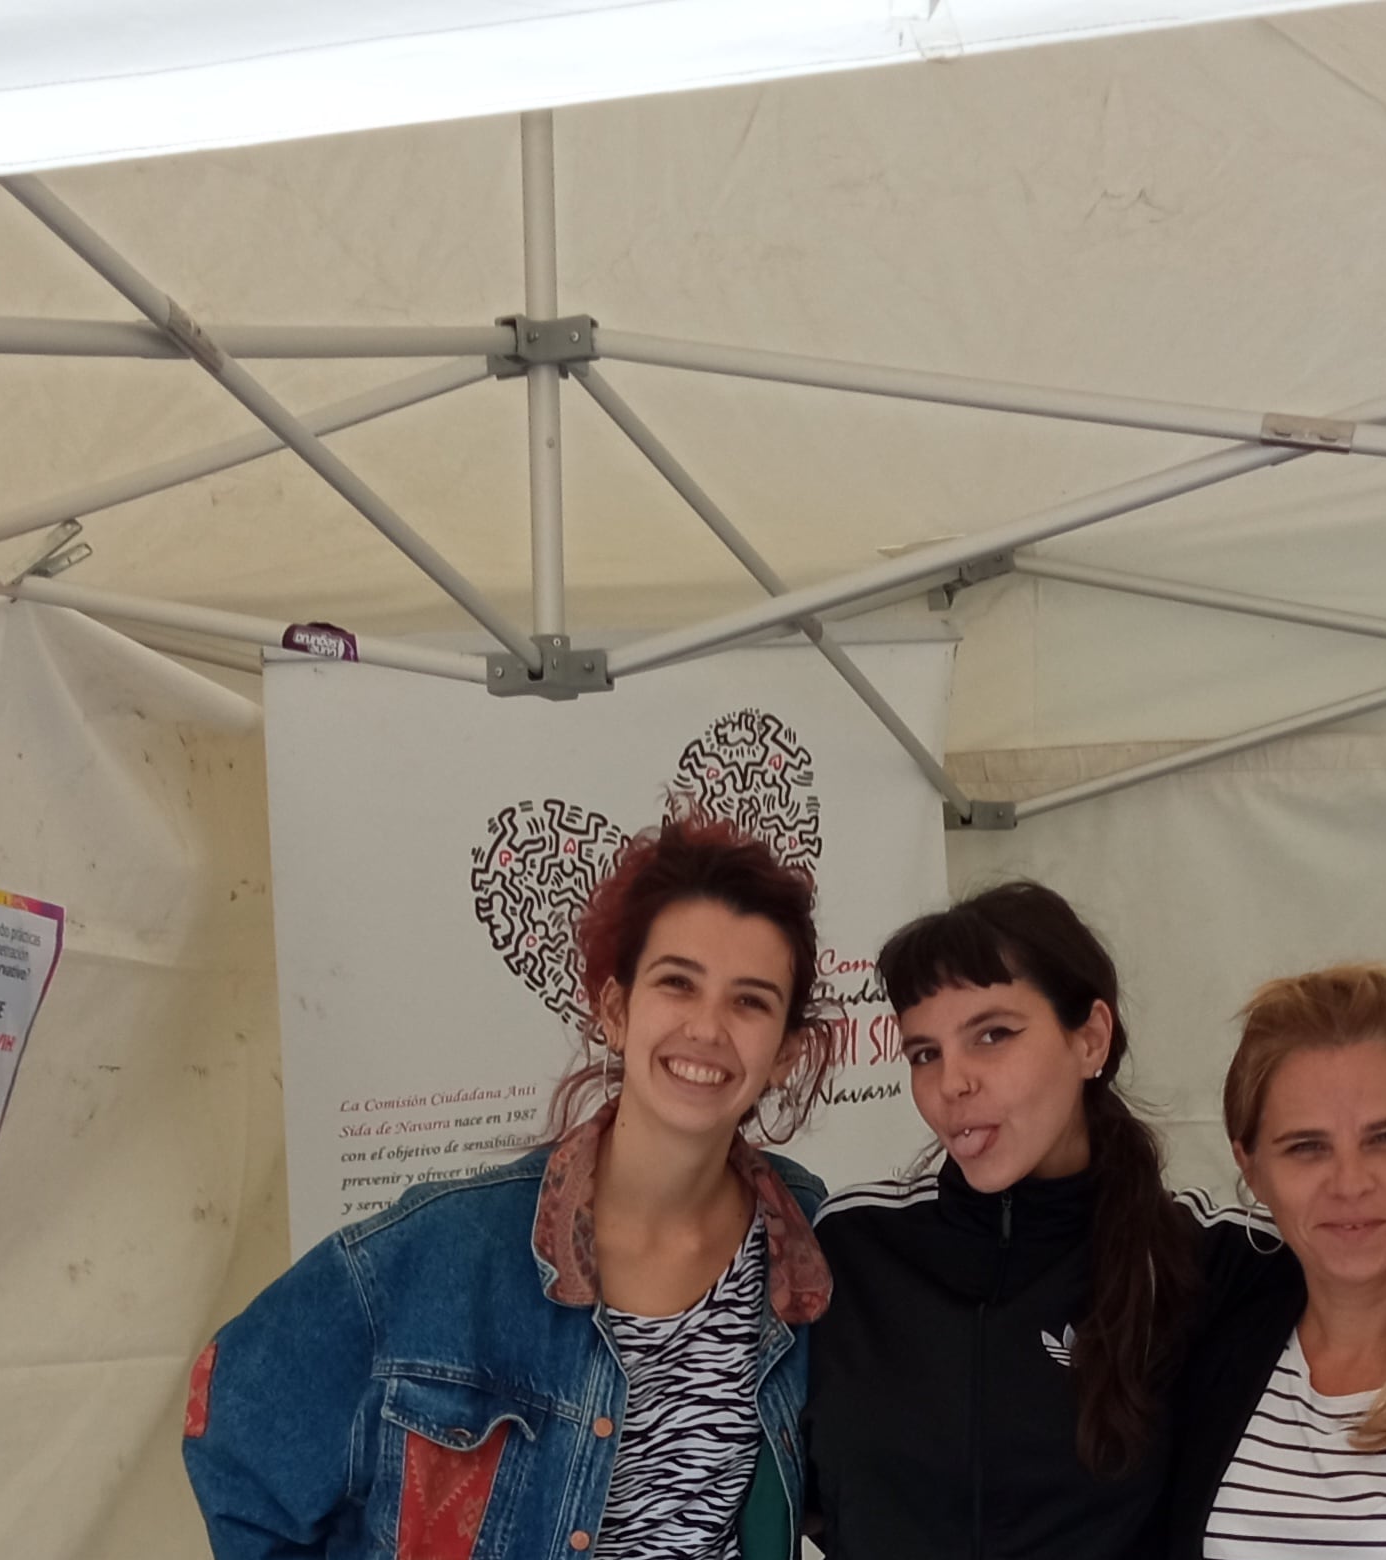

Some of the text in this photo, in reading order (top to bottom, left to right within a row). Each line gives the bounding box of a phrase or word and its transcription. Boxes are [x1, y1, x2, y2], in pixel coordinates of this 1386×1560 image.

[340, 1083, 537, 1113] La Comisión Ciudadana Anti
[818, 1078, 902, 1106] Navarra
[339, 1108, 537, 1138] Sida de Navarra nace en 1987
[341, 1150, 366, 1163] con
[370, 1145, 382, 1162] el
[386, 1140, 441, 1164] objetivo
[444, 1138, 459, 1154] de
[341, 1173, 400, 1190] prevenir
[404, 1173, 414, 1187] y
[417, 1168, 461, 1185] ofrecer
[341, 1197, 392, 1215] y servi
